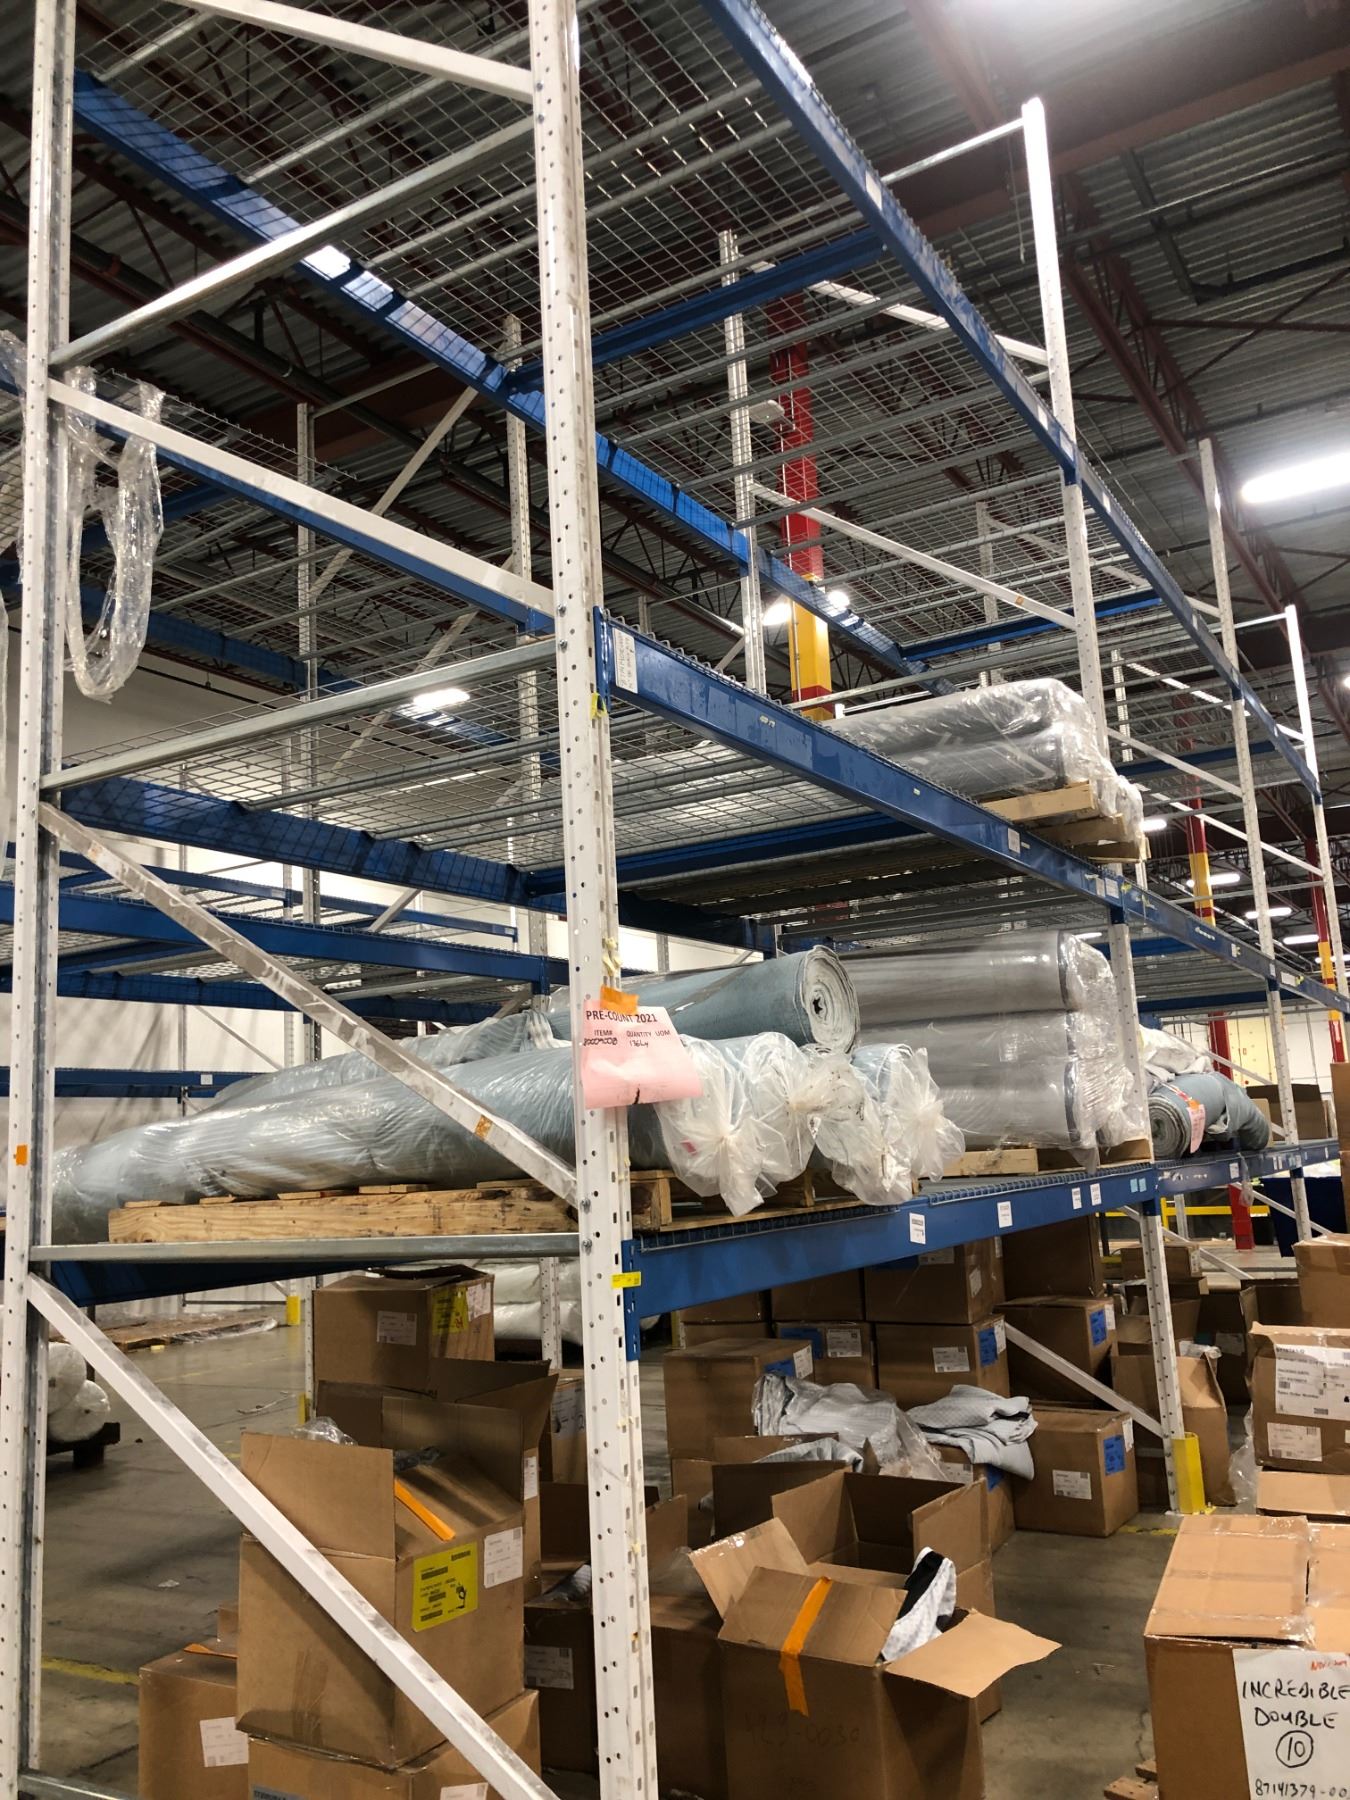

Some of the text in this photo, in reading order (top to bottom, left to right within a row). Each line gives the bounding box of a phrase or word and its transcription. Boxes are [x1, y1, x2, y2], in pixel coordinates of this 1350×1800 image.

[586, 1010, 658, 1023] PRE-COUNT 2021
[1242, 1679, 1350, 1700] INCREDIBLE
[1254, 1706, 1339, 1729] DOUBLE
[1286, 1737, 1306, 1761] 10
